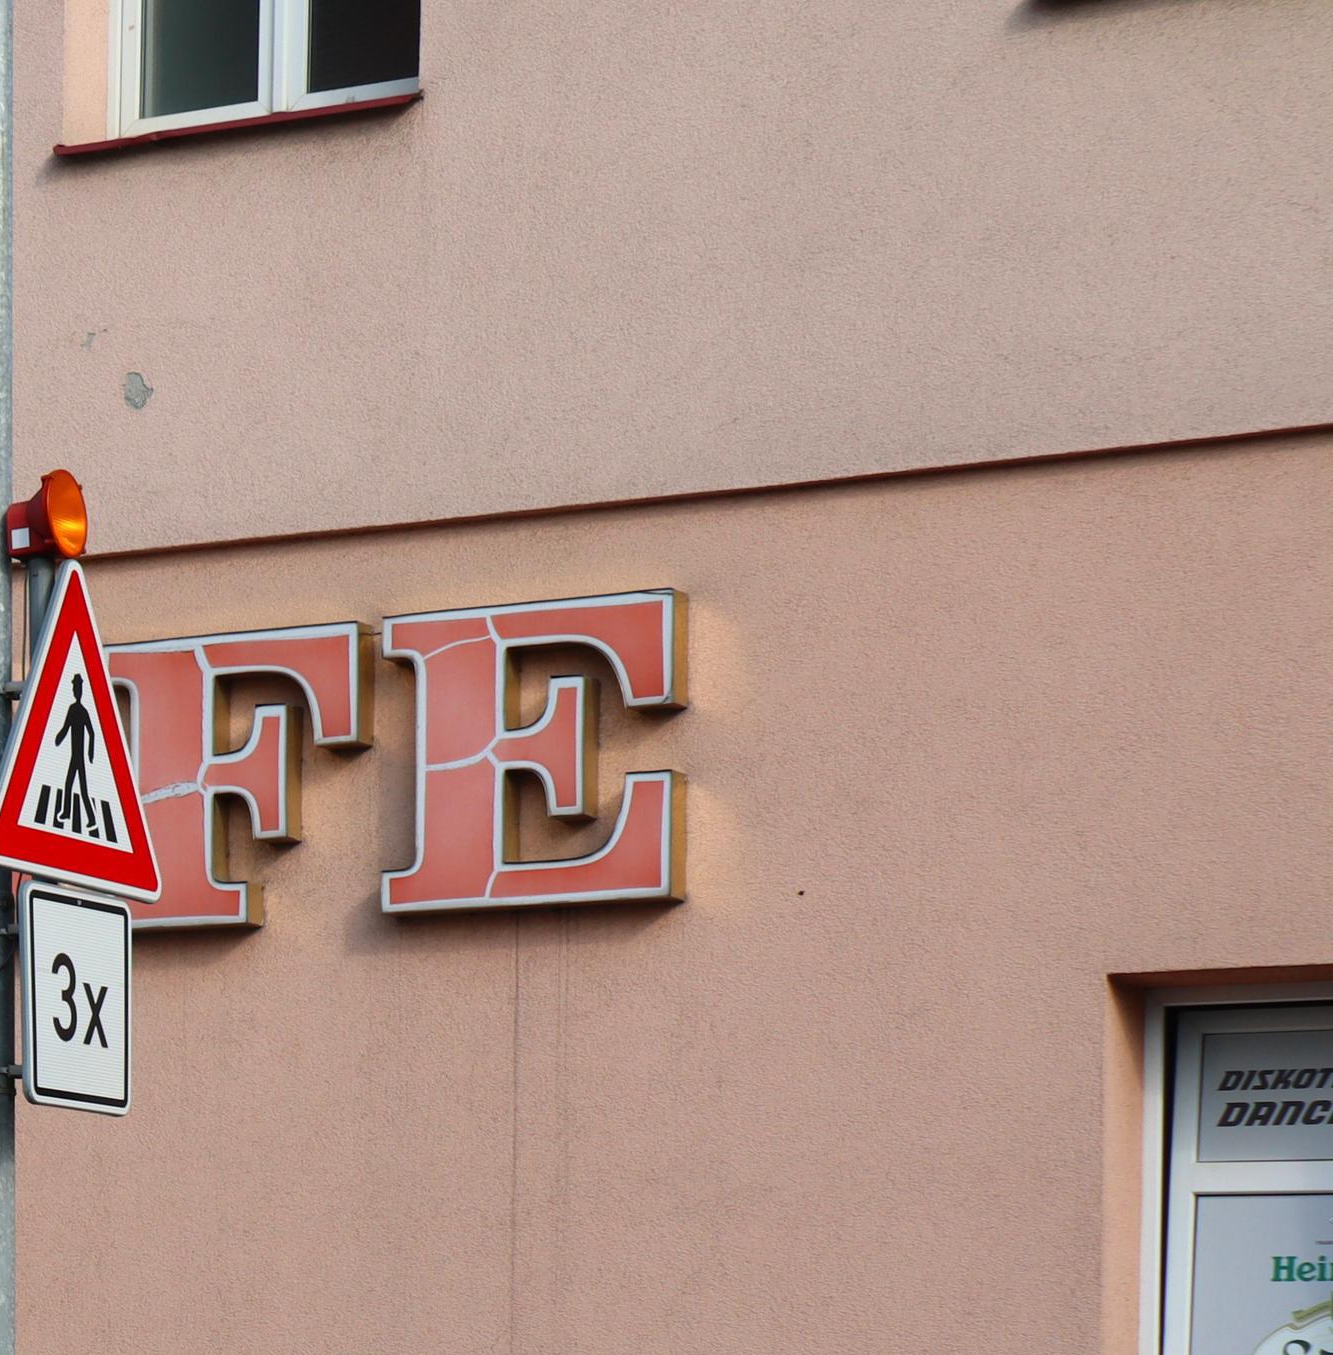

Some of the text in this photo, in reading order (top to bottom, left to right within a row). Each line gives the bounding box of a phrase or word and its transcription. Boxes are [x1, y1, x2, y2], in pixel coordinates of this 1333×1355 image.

[51, 953, 109, 1049] 3x
[1217, 1068, 1333, 1091] DISKOT
[1217, 1100, 1333, 1127] DANC
[1270, 1255, 1333, 1282] Hei
